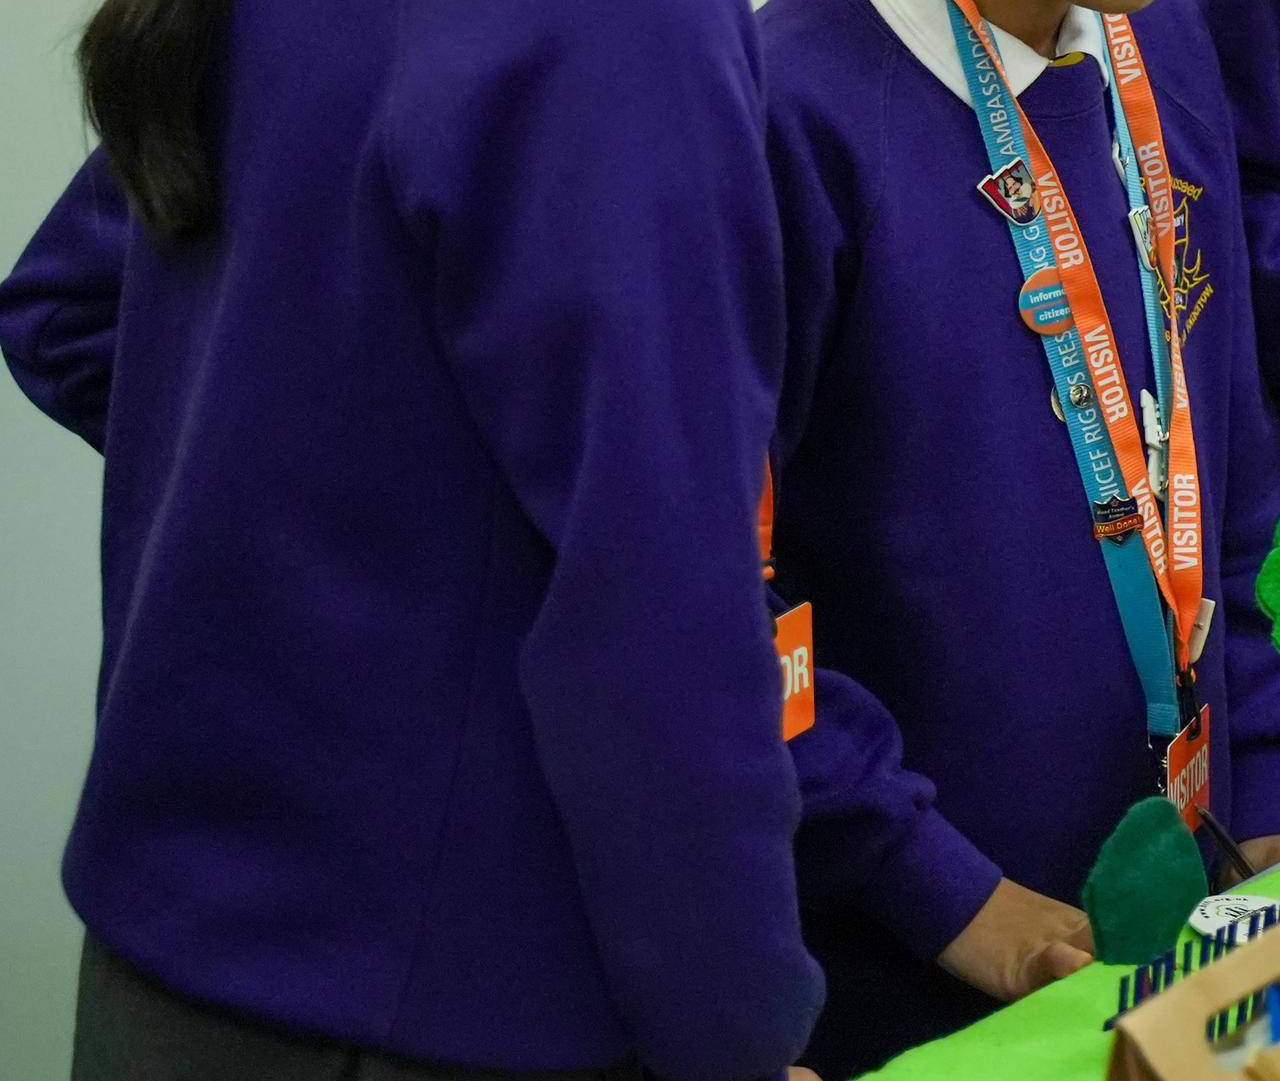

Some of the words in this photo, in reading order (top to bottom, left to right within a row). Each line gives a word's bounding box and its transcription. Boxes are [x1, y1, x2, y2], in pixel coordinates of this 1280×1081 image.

[1039, 171, 1085, 269] VISITOR
[1138, 141, 1170, 237] VISITOR
[1066, 370, 1102, 445] RIGS
[1084, 323, 1129, 424] VISITOR
[1174, 473, 1195, 570] VISITOR
[1170, 743, 1208, 814] VISITOR
